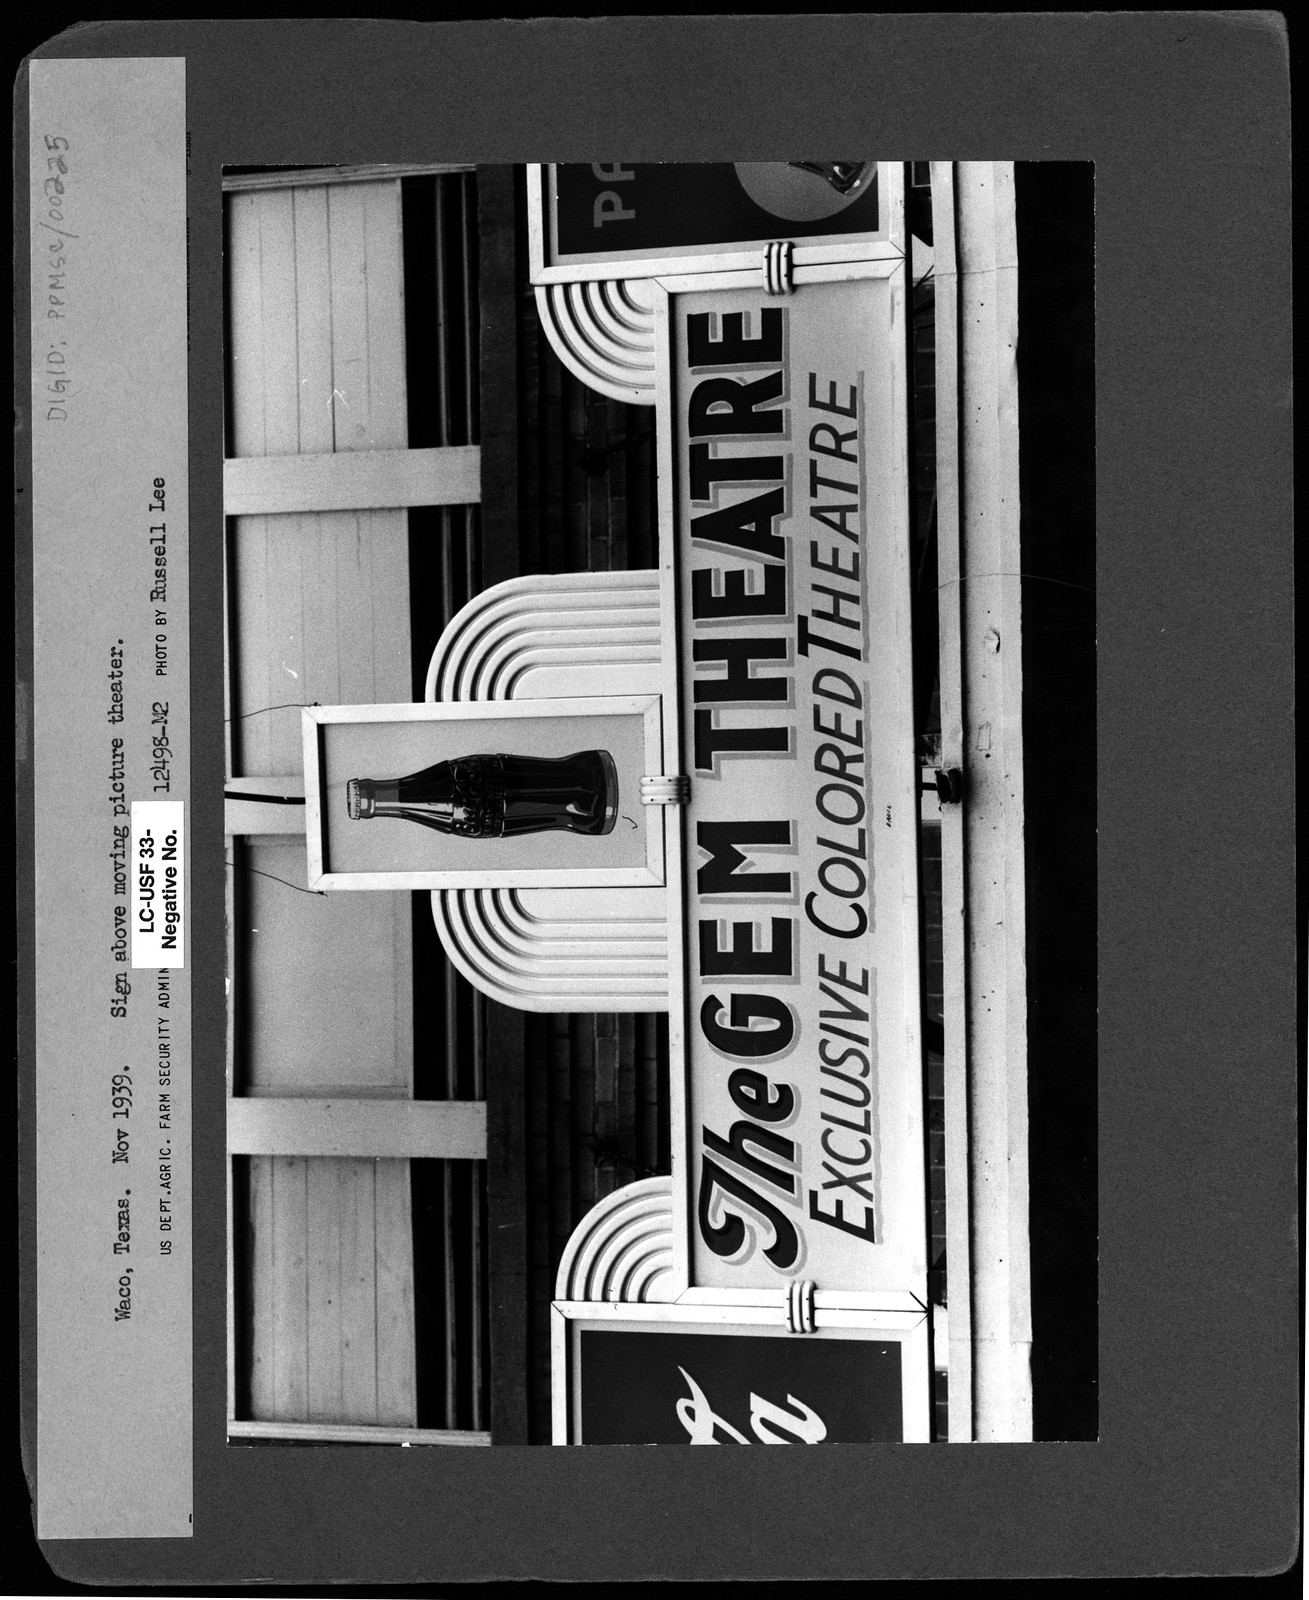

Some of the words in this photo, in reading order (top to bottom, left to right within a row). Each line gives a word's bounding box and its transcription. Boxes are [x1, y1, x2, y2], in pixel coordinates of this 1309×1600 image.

[149, 478, 165, 511] Lee
[797, 372, 861, 661] THEATRE
[150, 523, 167, 602] Russell
[688, 308, 788, 771] THEATRE
[155, 610, 167, 625] BY
[107, 639, 124, 724] theater.
[156, 634, 167, 675] PHOTO
[109, 738, 129, 817] picture
[150, 702, 172, 792] 12498-M2
[805, 669, 867, 938] COLORED
[109, 826, 129, 895] moving
[139, 830, 154, 858] 33-
[162, 830, 177, 860] No.
[139, 863, 154, 932] LC-USF
[162, 867, 180, 948] Negative
[111, 906, 128, 961] above
[697, 821, 793, 1056] GEM
[111, 972, 131, 1017] Sign
[158, 1018, 170, 1085] SECURITY
[112, 1066, 132, 1118] 1939.
[159, 1094, 170, 1128] FARM
[809, 954, 874, 1243] EXCLUSIVE
[112, 1128, 129, 1164] Nov
[698, 1069, 797, 1269] The
[113, 1189, 131, 1254] Texas.
[159, 1240, 171, 1255] US
[115, 1268, 133, 1321] Waco,
